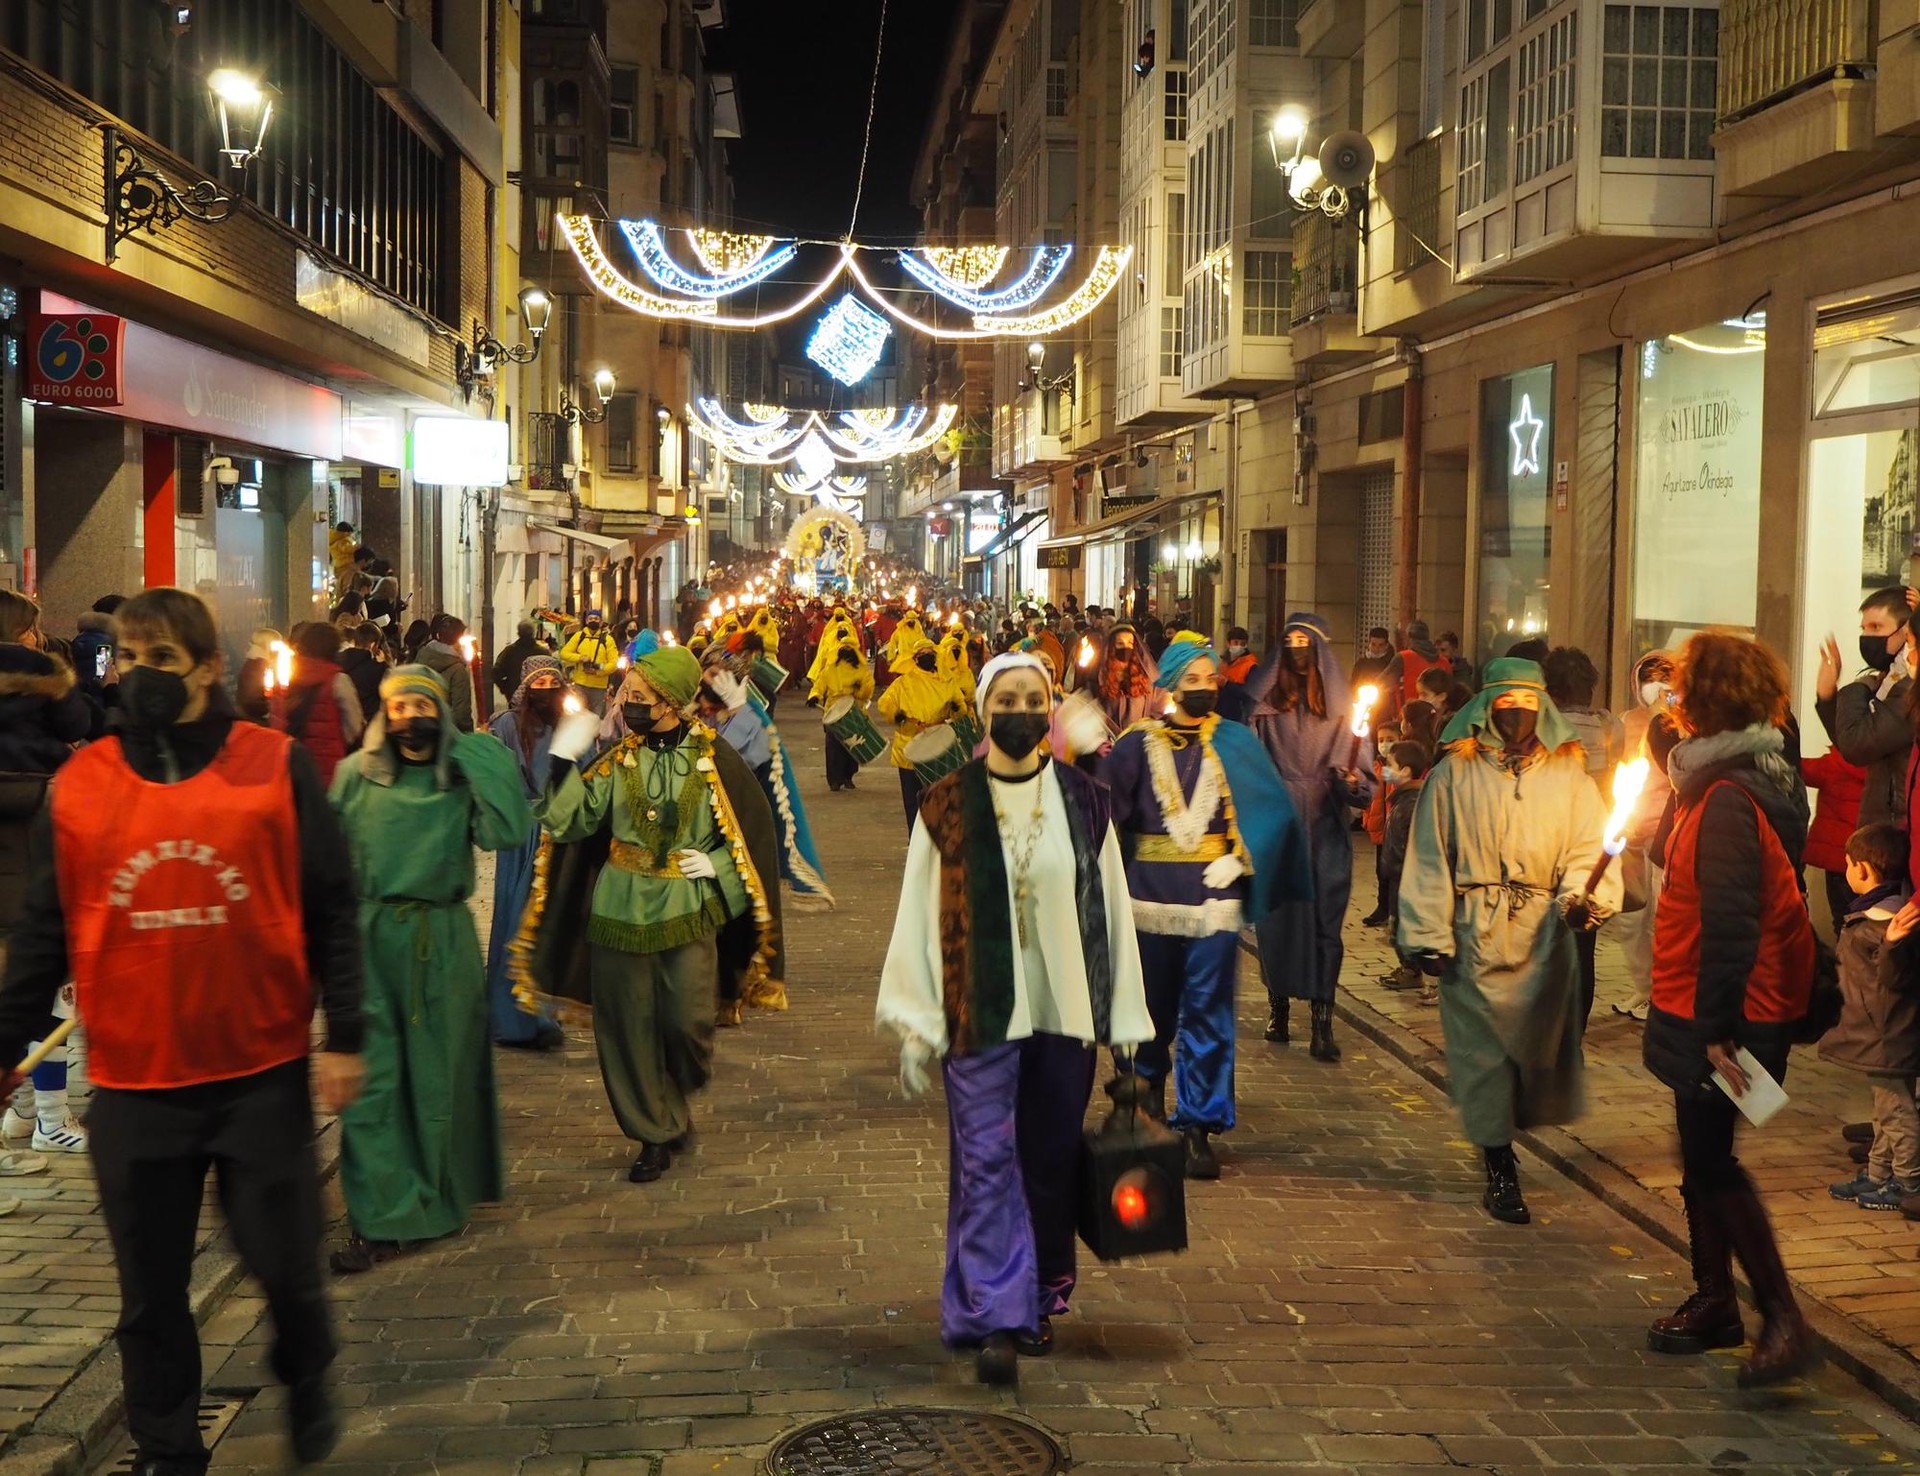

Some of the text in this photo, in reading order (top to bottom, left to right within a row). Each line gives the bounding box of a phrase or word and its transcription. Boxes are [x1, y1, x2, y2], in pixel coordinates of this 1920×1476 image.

[32, 384, 115, 399] EURO 6000
[205, 369, 268, 431] Santander
[1669, 400, 1729, 443] SAYALERO
